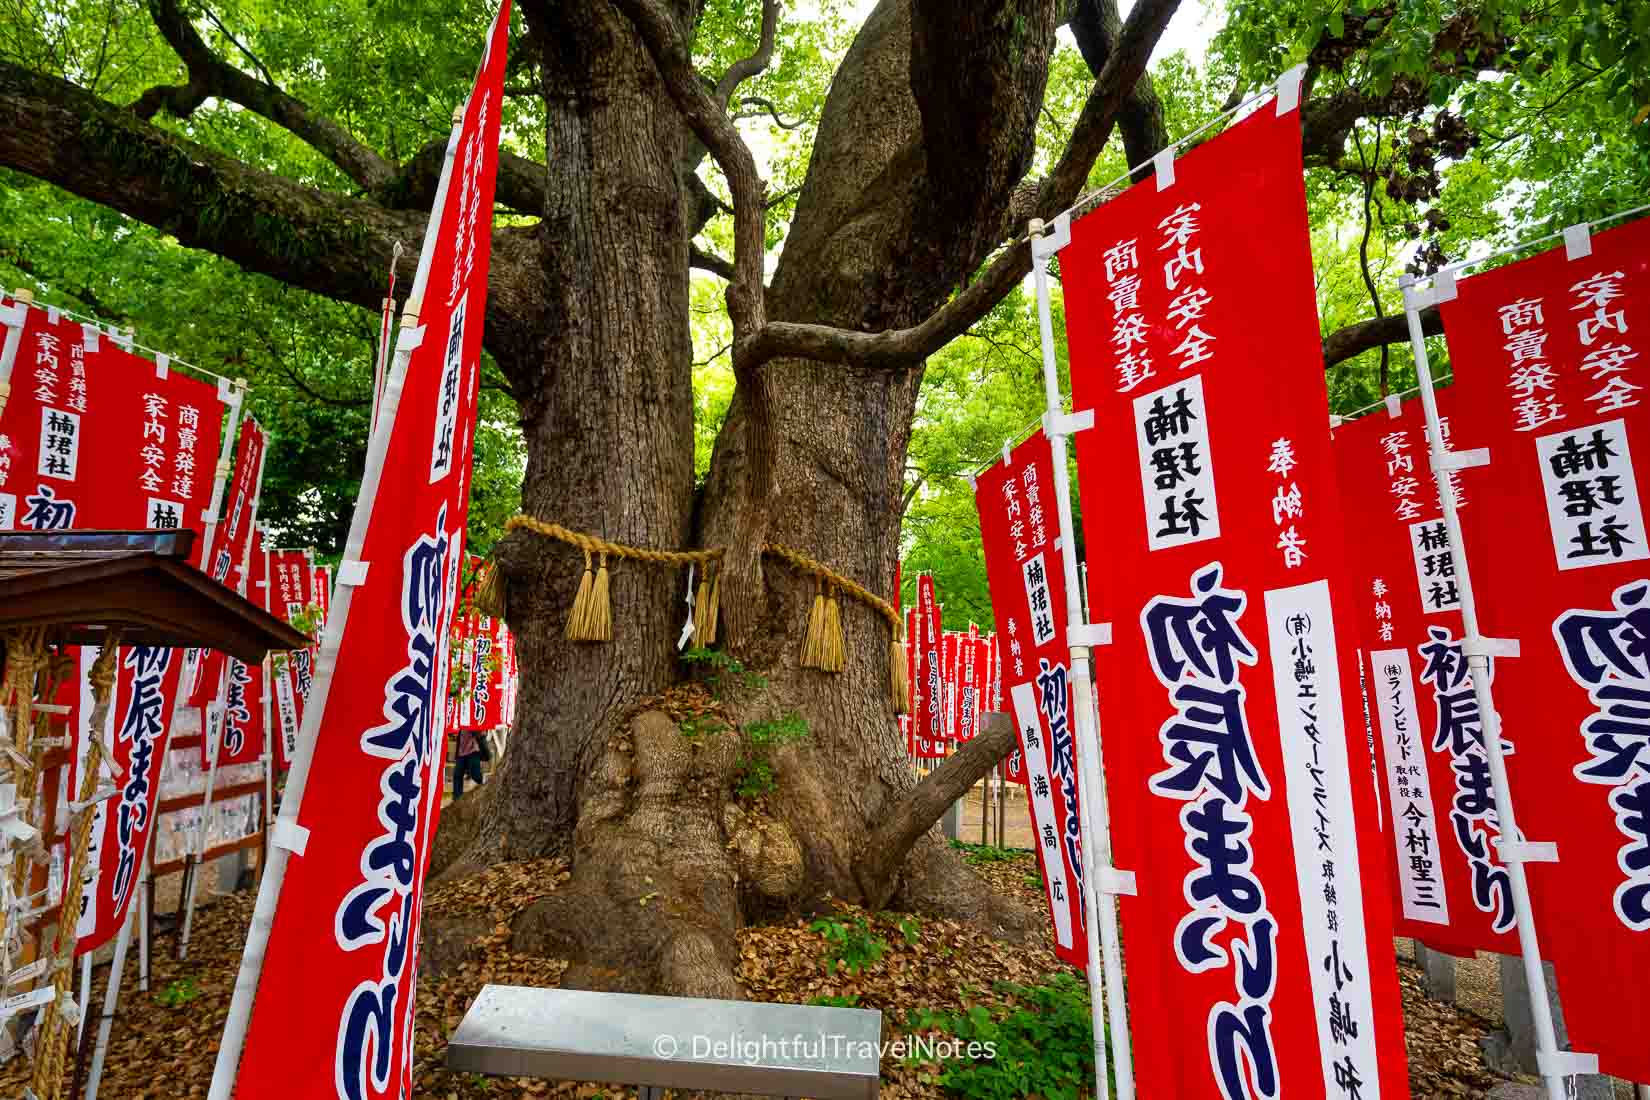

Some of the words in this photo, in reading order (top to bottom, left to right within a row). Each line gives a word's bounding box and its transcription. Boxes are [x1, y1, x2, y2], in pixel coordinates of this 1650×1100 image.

[33, 331, 61, 405] 家内安全
[46, 411, 76, 476] 楠珺社
[139, 392, 169, 493] 家内安全
[171, 403, 200, 499] 商賣発達
[1379, 430, 1425, 522] 家内安全
[1001, 477, 1028, 562] 家内安全
[1026, 559, 1054, 642] 楠珺社
[1371, 577, 1395, 642] 奉納者
[1006, 616, 1024, 677] 奉納者
[114, 645, 172, 918] 初辰まいり
[1024, 725, 1065, 902] 鳥海高広
[1401, 800, 1442, 909] 今村聖三
